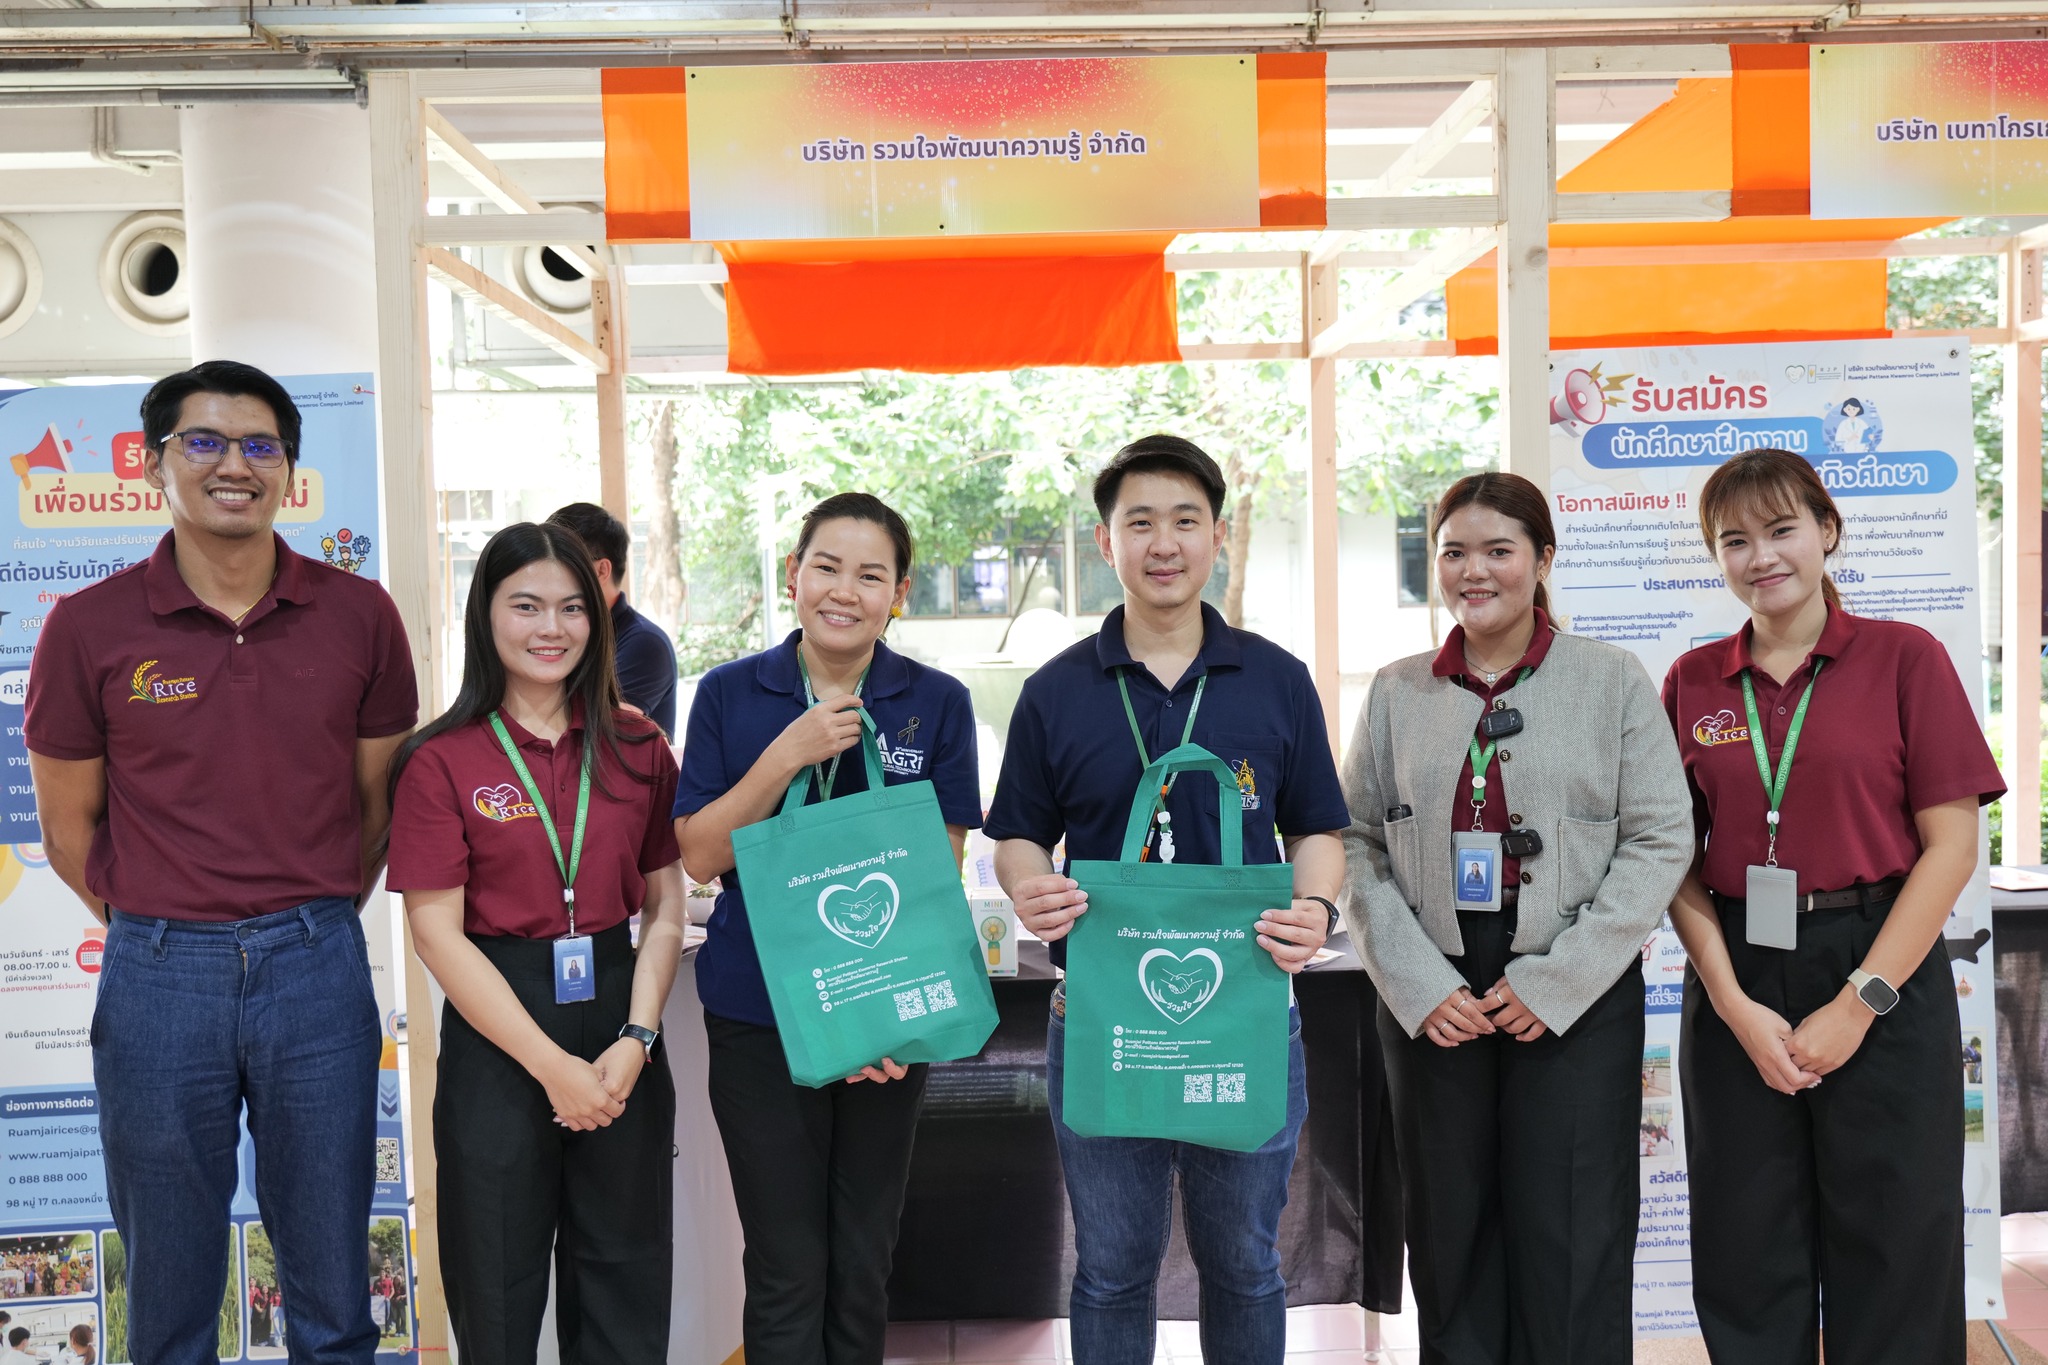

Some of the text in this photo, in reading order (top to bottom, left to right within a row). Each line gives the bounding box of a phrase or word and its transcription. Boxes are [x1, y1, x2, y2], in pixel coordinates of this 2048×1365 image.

[1876, 118, 1938, 142] บริษัท
[802, 131, 1147, 162] บริษัท รวมใจพัฒนาความรู้ จำกัด
[1632, 375, 1768, 413] รับสมัคร
[1815, 455, 1929, 490] กิจศึกษา
[34, 478, 163, 514] เพื่อนร่วม
[1556, 492, 1670, 513] โอกาสพิเศษ
[13, 536, 47, 550] ที่สนใจ
[1643, 574, 1727, 591] ประสบการณ์
[3, 679, 29, 699] กลุ่
[788, 847, 908, 889] บริษัท รวมใจพัฒนาความรู้ จำกัด
[854, 924, 879, 938] รวมใจ
[1117, 927, 1245, 943] บริษัท รวมใจพัฒนาความรู้ จำกัด
[52, 948, 70, 957] เสาร์
[4, 962, 60, 972] 08.00-17.00
[1167, 1001, 1193, 1013] รวมใจ
[5, 1026, 91, 1040] เงินเดือนตามโครงสร้า
[6, 1096, 94, 1112] ช่องทางการติดต่อ
[9, 1172, 88, 1185] 0 888 888 000
[6, 1199, 20, 1209] 98
[23, 1197, 36, 1209] หมู่
[38, 1198, 49, 1207] 17
[1634, 1309, 1694, 1319] Ruamjai Pattana
